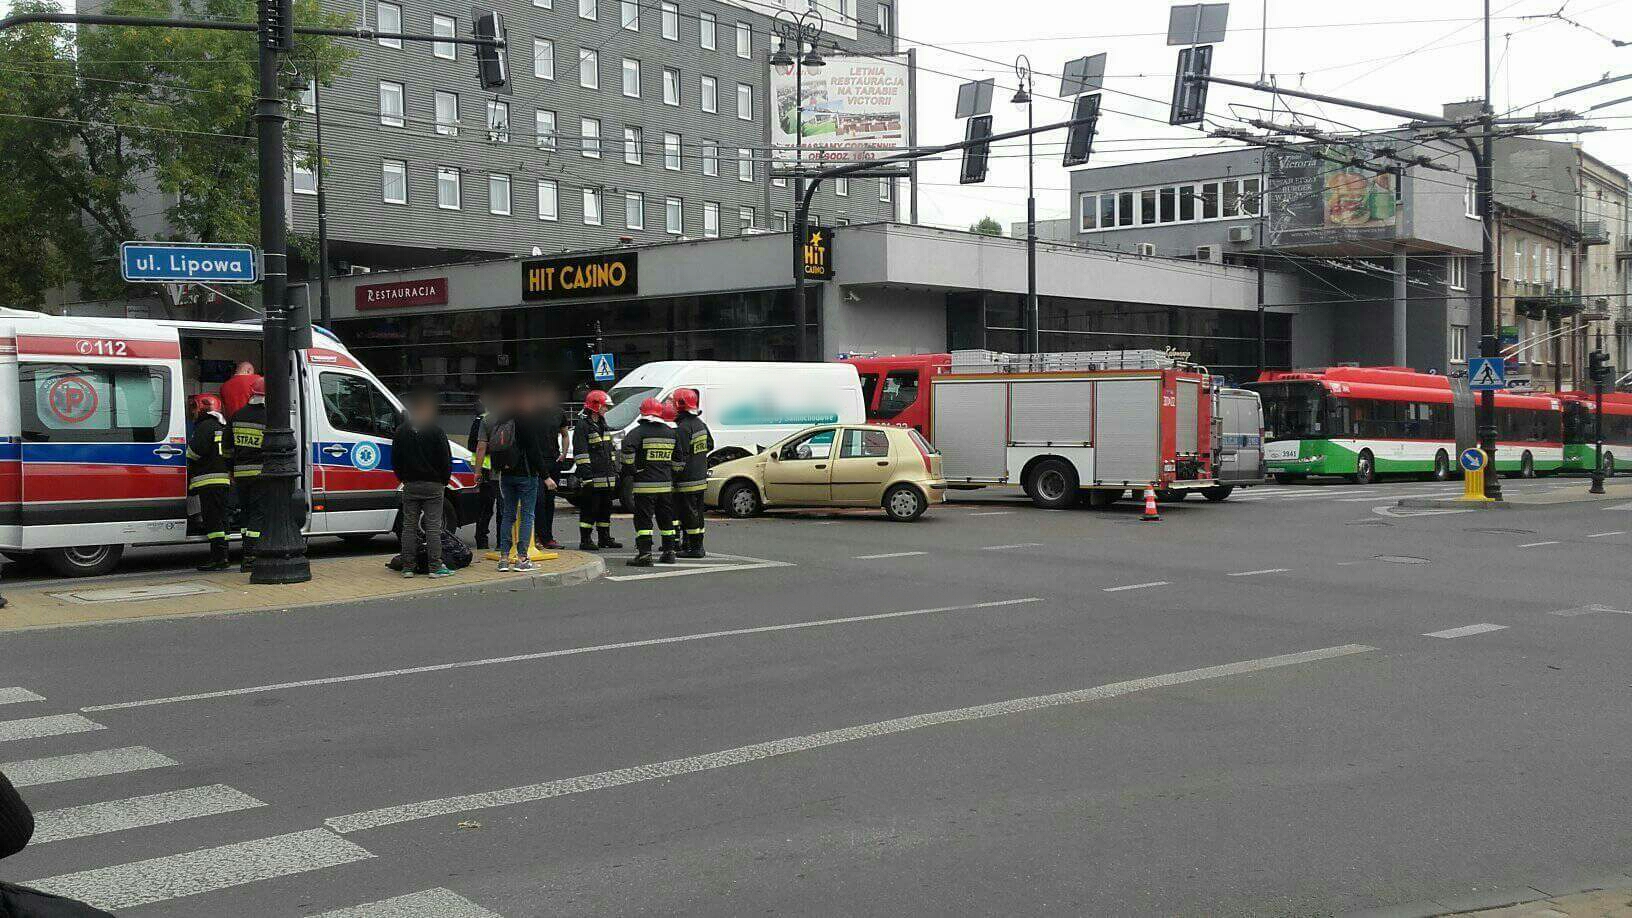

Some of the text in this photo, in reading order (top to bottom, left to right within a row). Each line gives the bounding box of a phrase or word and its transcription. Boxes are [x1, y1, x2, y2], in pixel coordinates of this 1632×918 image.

[850, 67, 886, 76] LETNIA
[830, 76, 904, 86] RESTAURACJA
[837, 86, 852, 95] NA
[847, 96, 892, 106] VICTORII
[804, 244, 825, 266] HIT
[136, 254, 242, 276] ul. Lipowa
[529, 261, 627, 292] HIT CASINO
[367, 286, 436, 302] RESTAURACJA
[94, 340, 127, 356] 112
